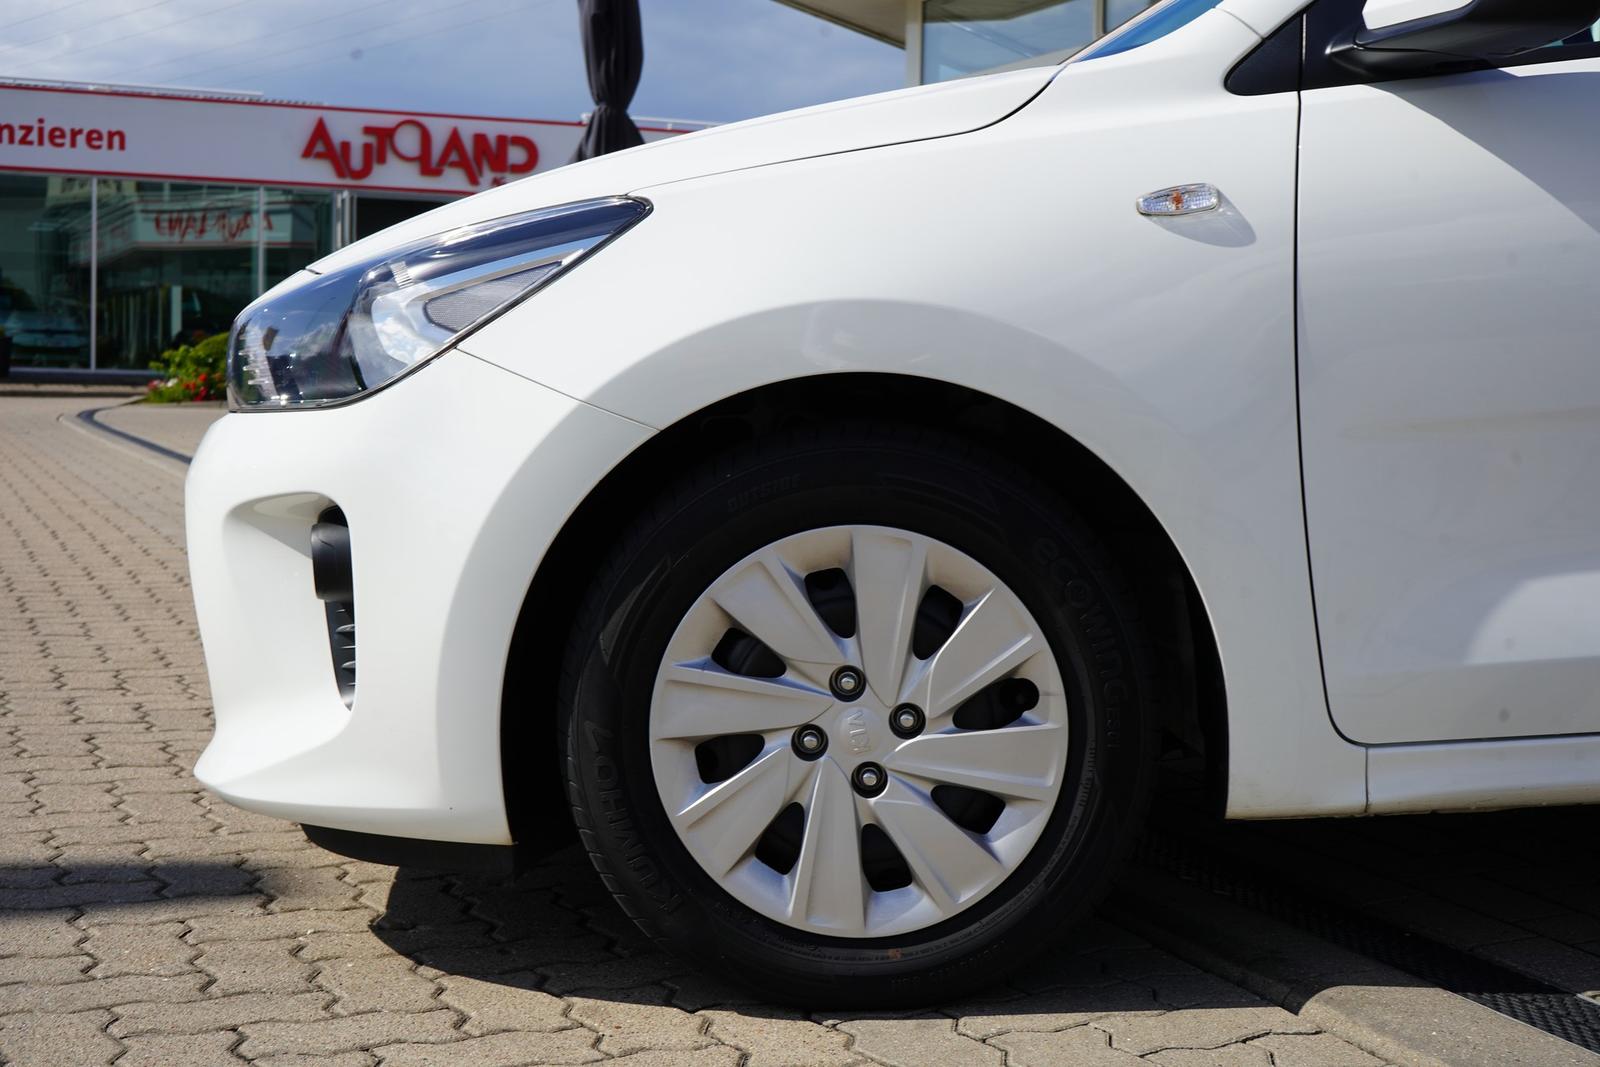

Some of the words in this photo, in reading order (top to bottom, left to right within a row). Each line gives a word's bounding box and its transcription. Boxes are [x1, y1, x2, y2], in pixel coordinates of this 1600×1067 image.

[0, 118, 125, 151] nzieren
[301, 116, 539, 186] AUTOLAND
[594, 755, 683, 913] KUMHO
